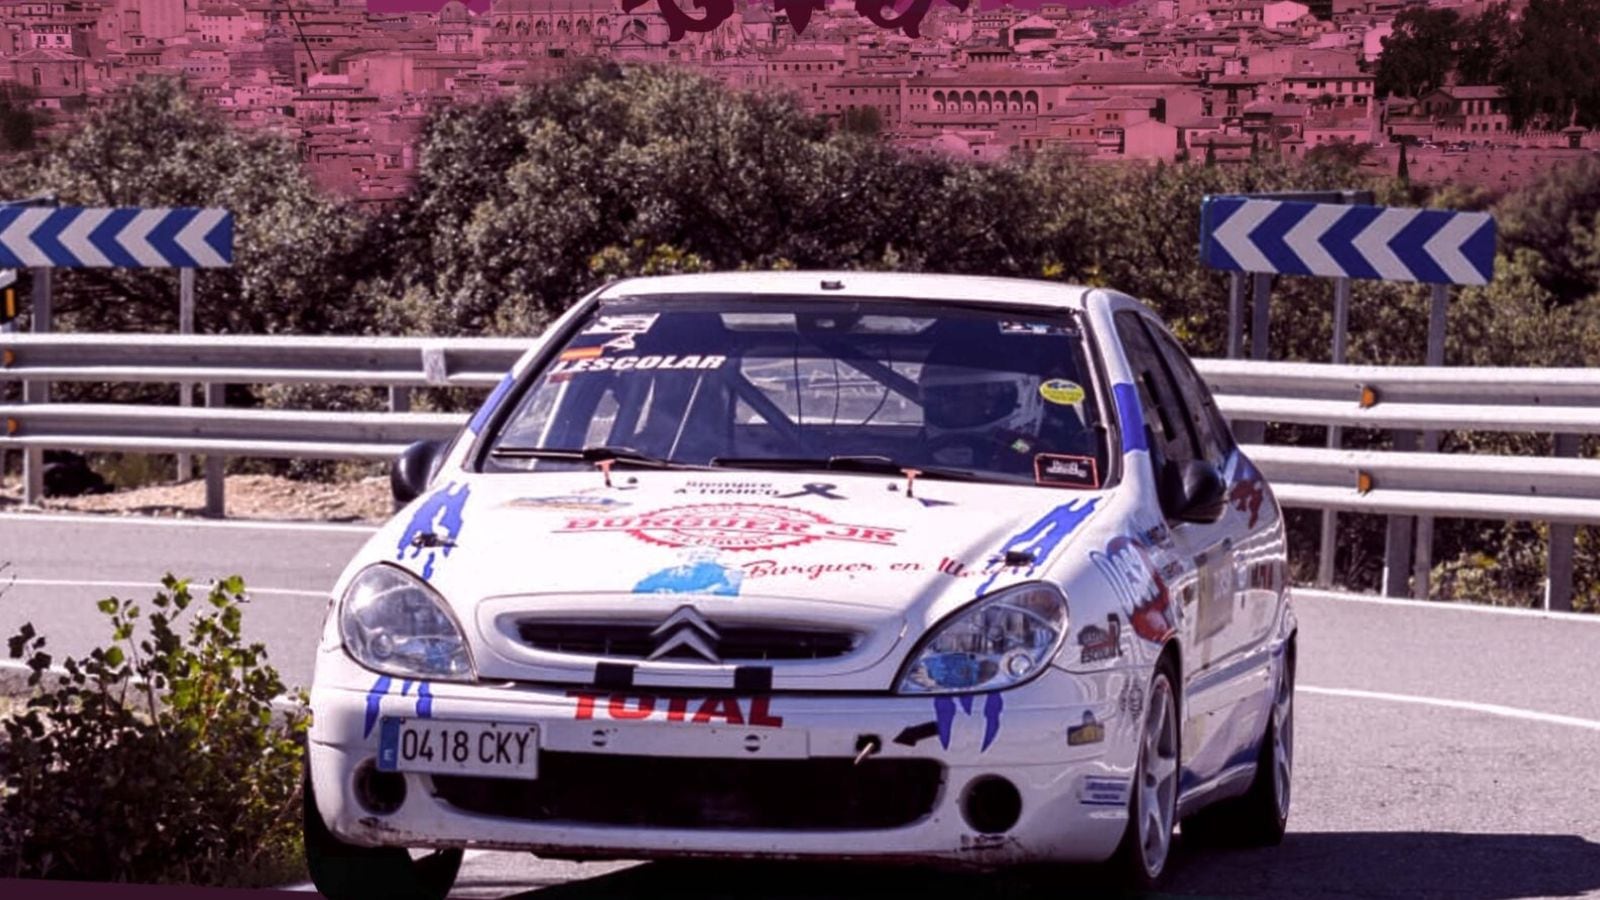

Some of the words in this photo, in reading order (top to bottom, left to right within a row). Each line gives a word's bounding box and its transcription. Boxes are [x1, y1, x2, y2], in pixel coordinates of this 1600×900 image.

[566, 515, 811, 533] BURGUER
[825, 527, 896, 541] JR
[742, 559, 875, 580] Burguer
[889, 561, 923, 572] en
[566, 690, 783, 728] TOTAL
[402, 728, 468, 763] 0418
[478, 730, 530, 765] CKY
